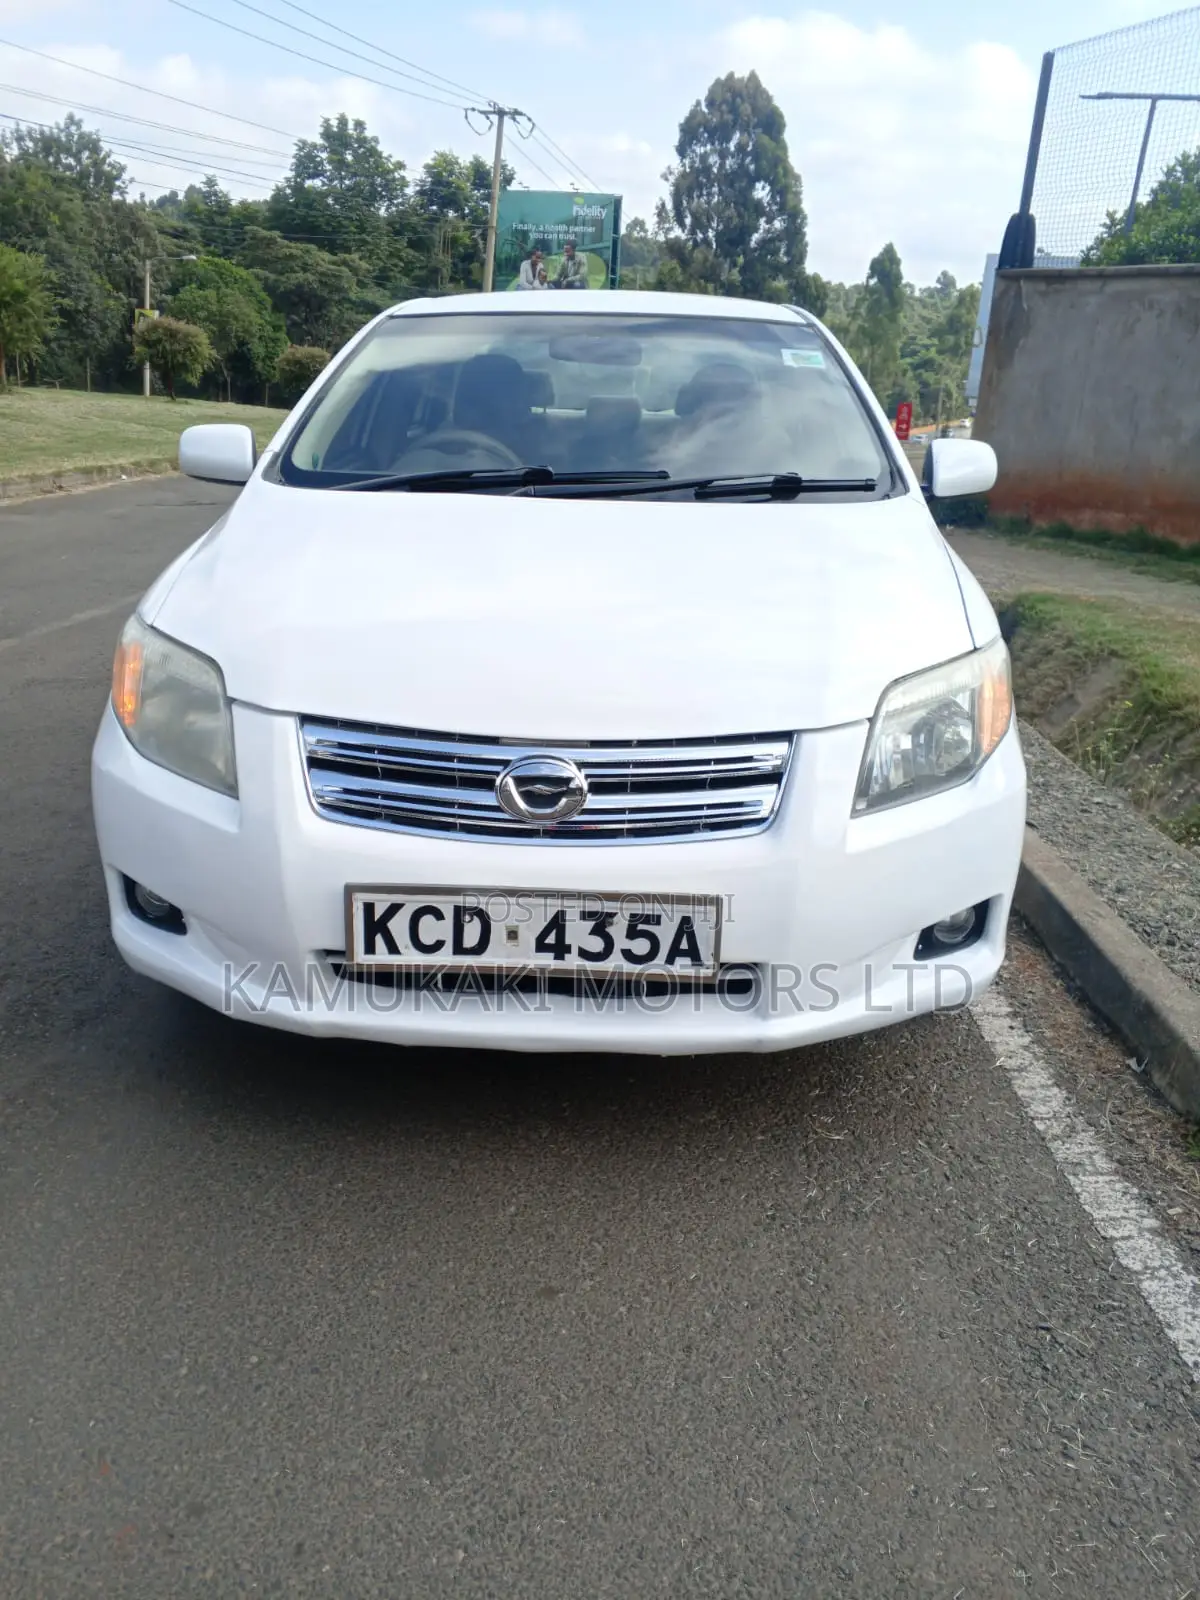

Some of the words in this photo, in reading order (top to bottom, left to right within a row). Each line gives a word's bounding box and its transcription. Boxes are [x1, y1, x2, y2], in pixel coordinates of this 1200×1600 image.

[545, 223, 568, 232] health
[569, 225, 596, 233] partner
[529, 232, 543, 240] you
[363, 902, 492, 957] KCD
[534, 909, 704, 966] 435A
